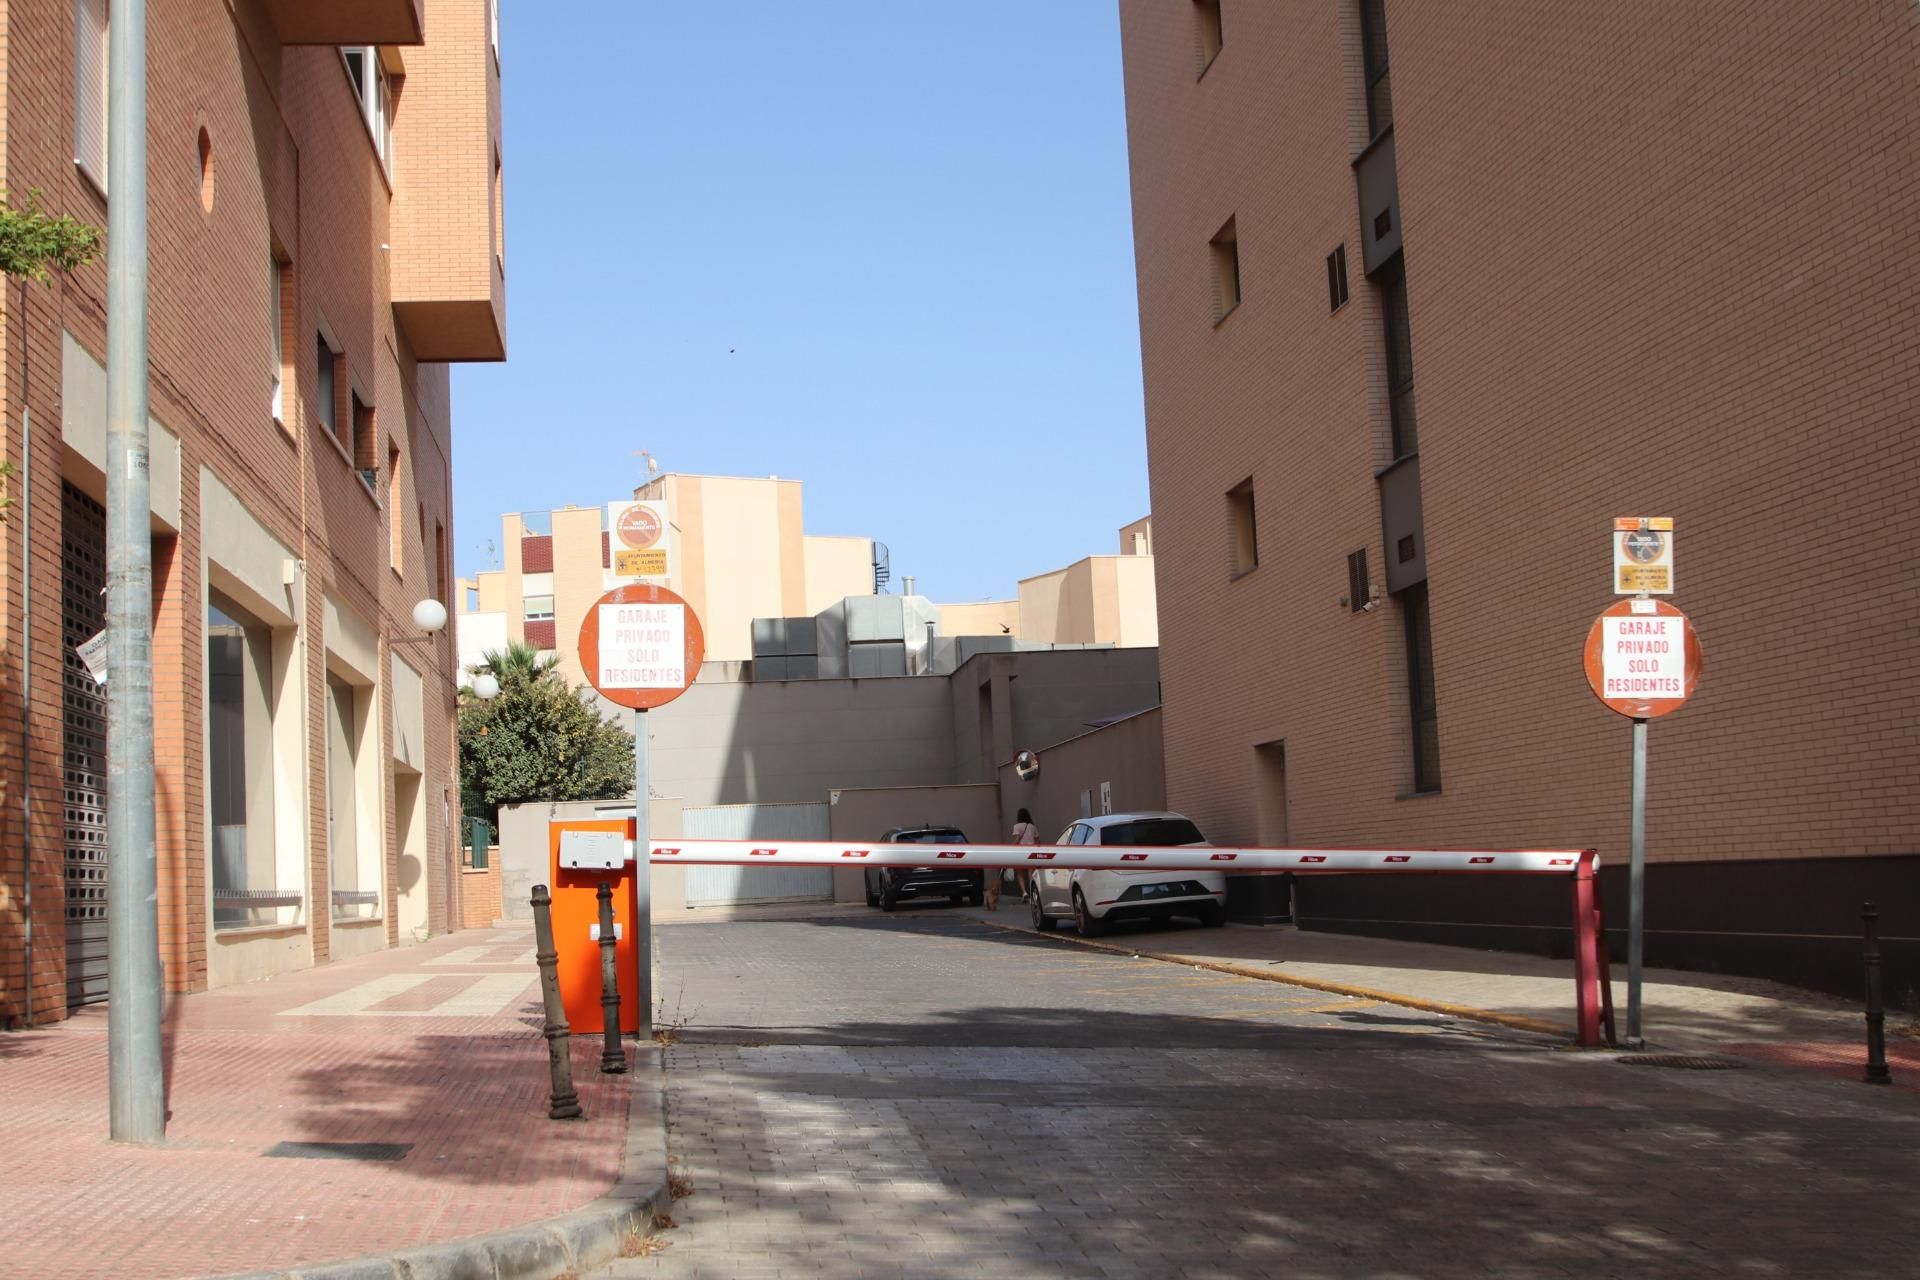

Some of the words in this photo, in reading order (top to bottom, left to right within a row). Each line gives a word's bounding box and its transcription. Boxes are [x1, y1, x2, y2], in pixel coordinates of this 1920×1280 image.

[618, 609, 668, 624] GARAJE
[1619, 621, 1666, 635] GARAJE
[615, 629, 670, 643] PRIVADO
[1617, 640, 1669, 654] PRIVADO
[627, 649, 660, 663] SOLO
[1628, 659, 1659, 673] SOLO
[605, 668, 682, 683] RESIDENTES
[1607, 678, 1680, 692] RESIDENTES
